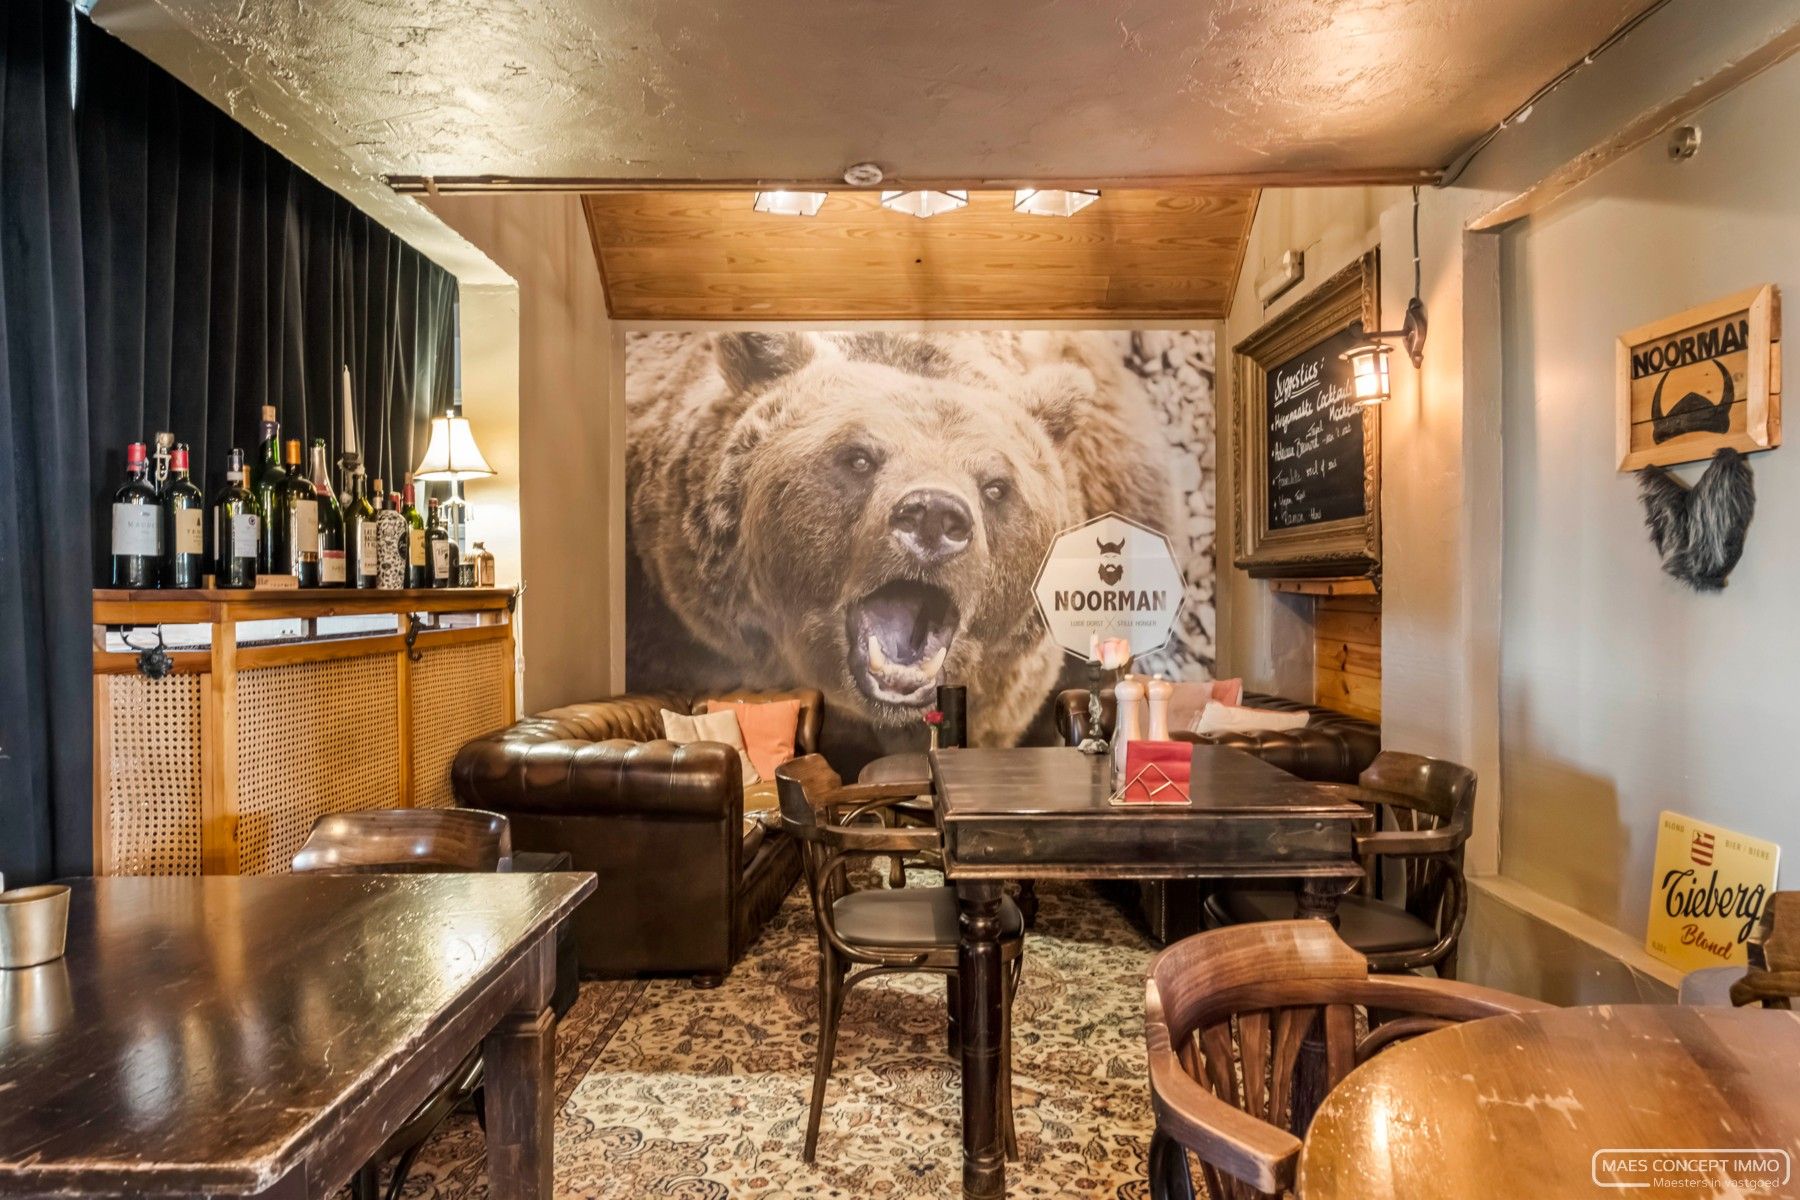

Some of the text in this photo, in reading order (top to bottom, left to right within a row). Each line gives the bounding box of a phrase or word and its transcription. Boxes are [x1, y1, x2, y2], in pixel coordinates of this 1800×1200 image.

[1054, 590, 1167, 612] NOORMAN
[1661, 869, 1766, 945] Tieberg
[1680, 923, 1734, 961] Blond
